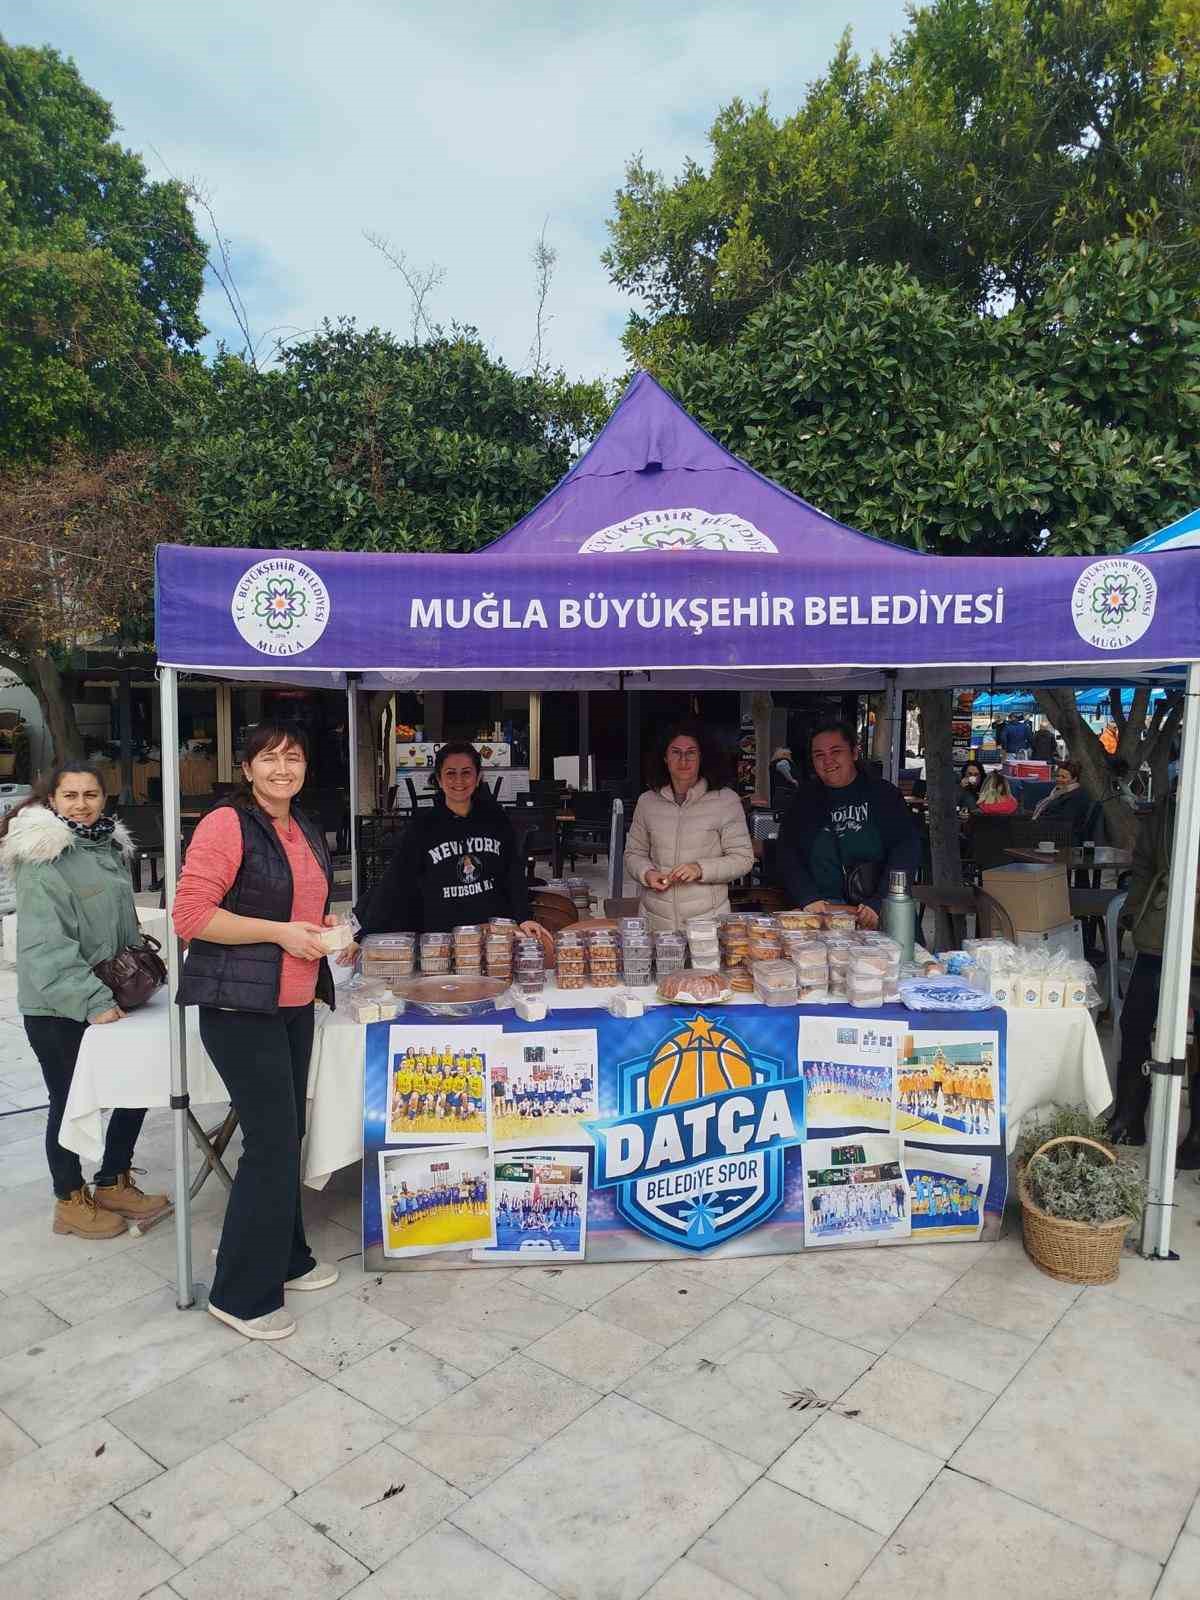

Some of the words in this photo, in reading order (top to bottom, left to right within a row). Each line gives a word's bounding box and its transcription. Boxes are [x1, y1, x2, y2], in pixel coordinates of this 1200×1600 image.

[238, 560, 295, 598] BÜYÜKŞEHİR
[409, 592, 548, 628] MUĞLA
[559, 591, 794, 635] BÜYÜKŞEHİR
[804, 587, 1004, 626] BELEDİYESİ
[257, 640, 304, 654] MUĞLA
[428, 840, 463, 864] NEW
[466, 837, 501, 856] YORK
[443, 882, 482, 898] HUDSON
[598, 1089, 798, 1178] DATÇA
[718, 1160, 757, 1185] SPOR
